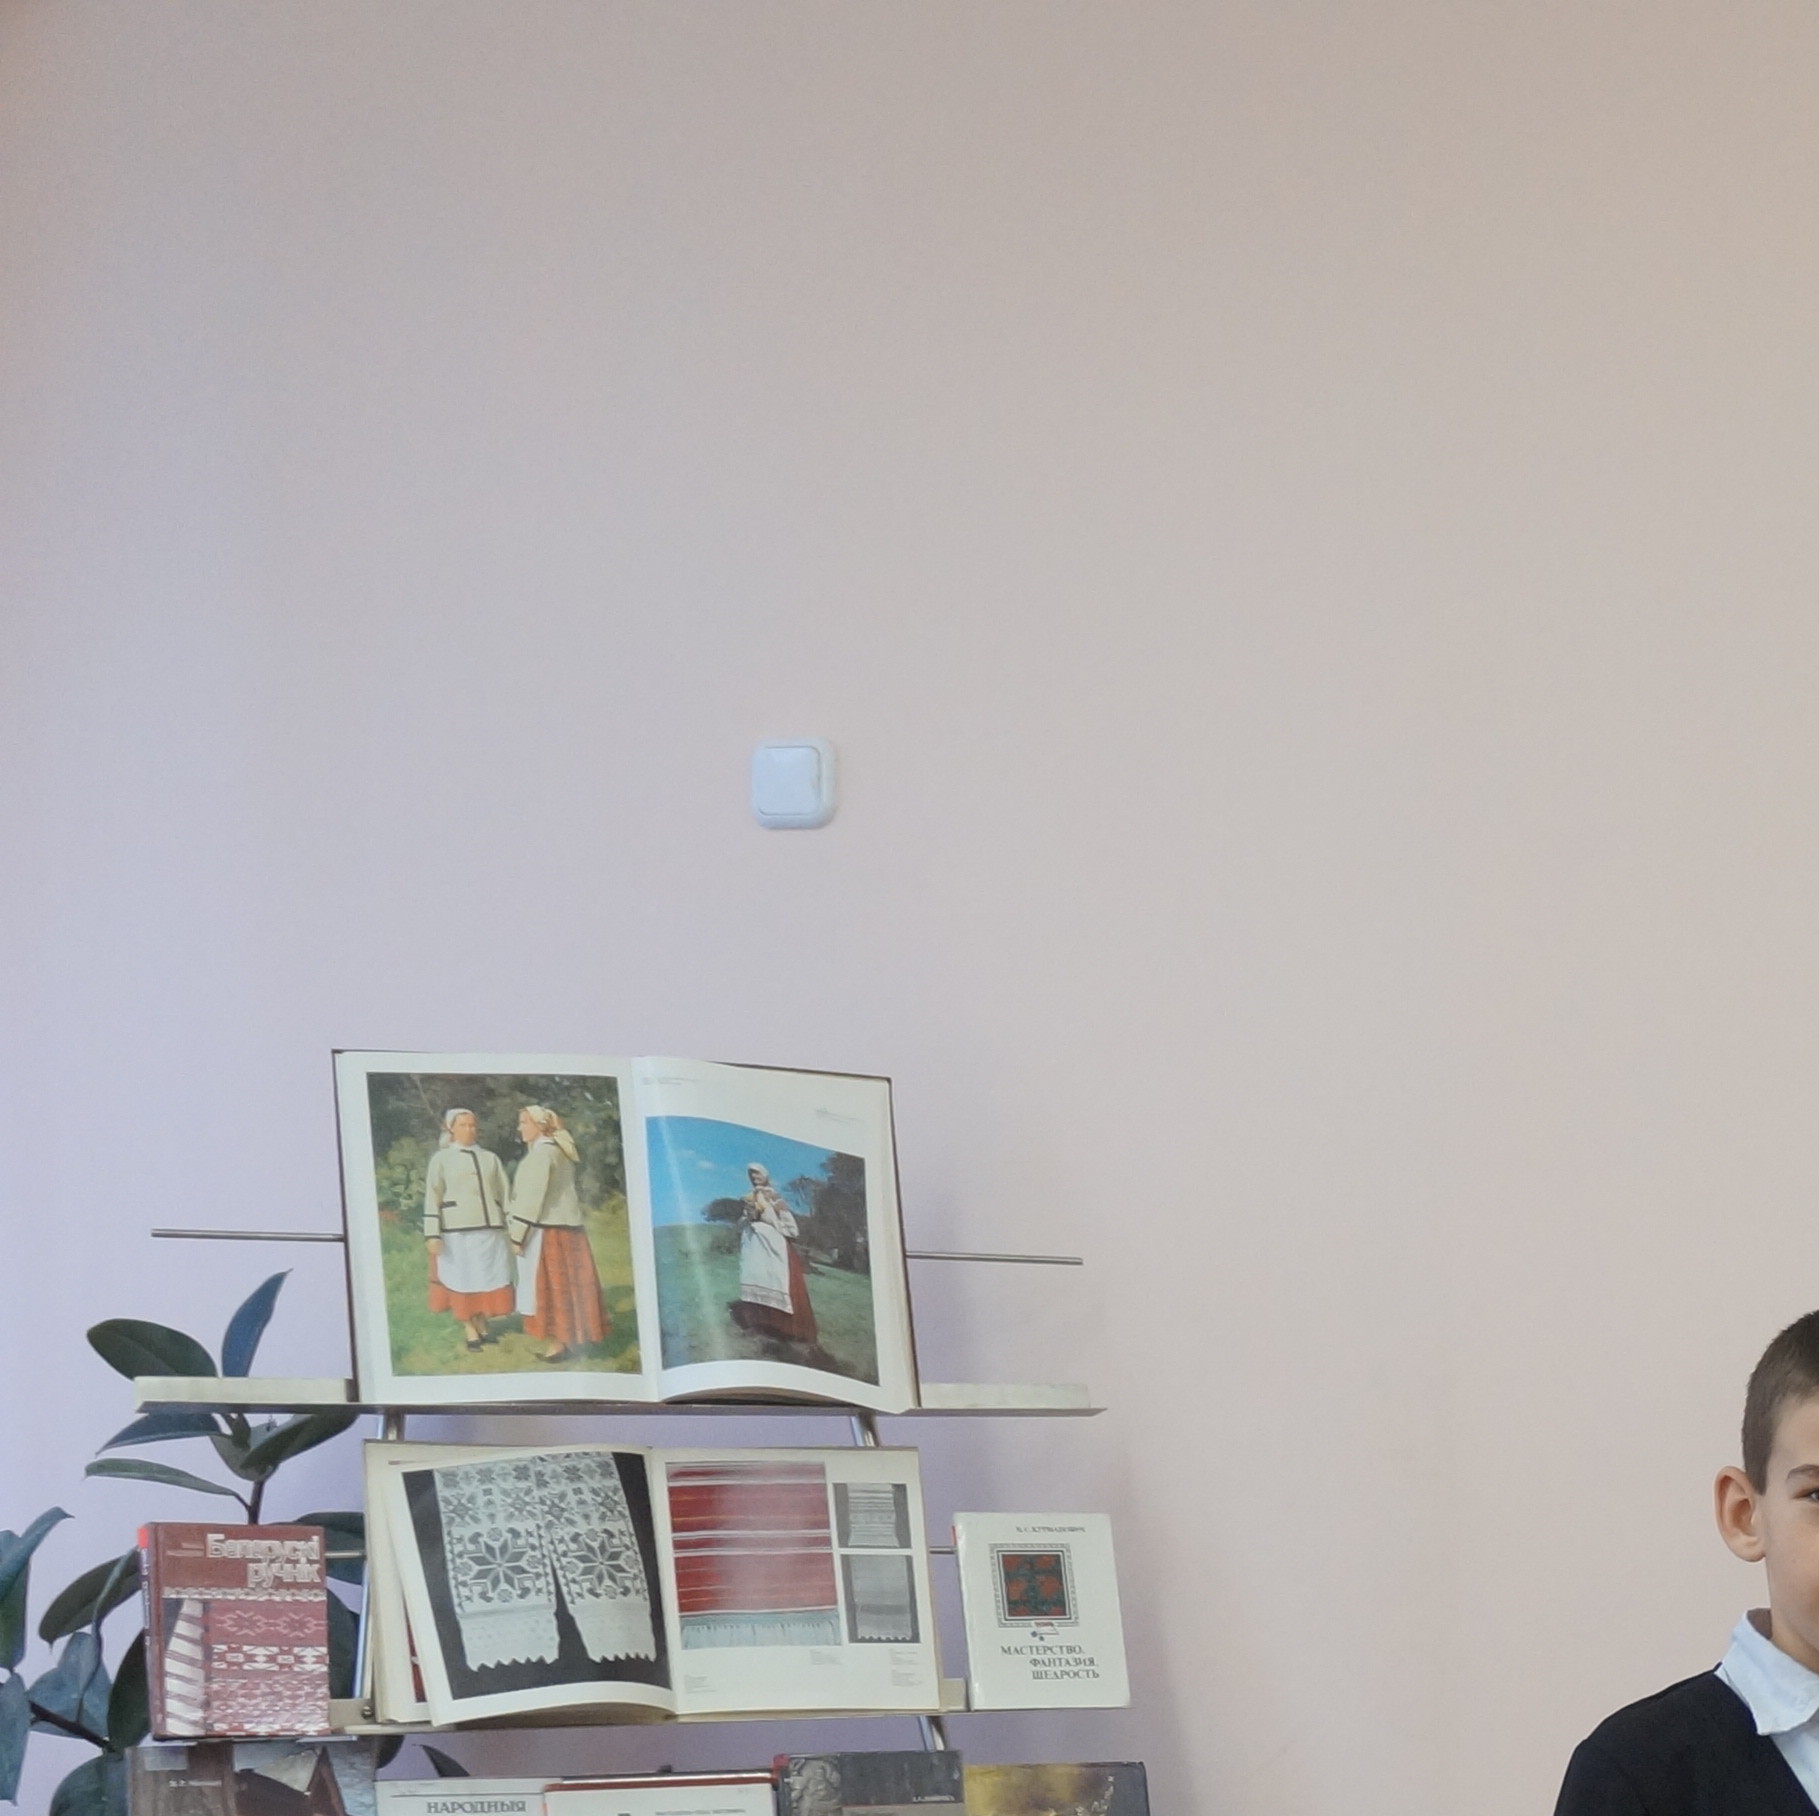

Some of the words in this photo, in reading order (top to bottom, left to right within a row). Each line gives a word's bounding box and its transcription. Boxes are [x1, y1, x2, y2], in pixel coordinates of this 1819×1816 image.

[1000, 1644, 1085, 1656] МАСТЕРСТВО.
[1031, 1669, 1100, 1680] ЩЕДРОСТЬ
[426, 1800, 526, 1814] НАРОДНЫЯ
